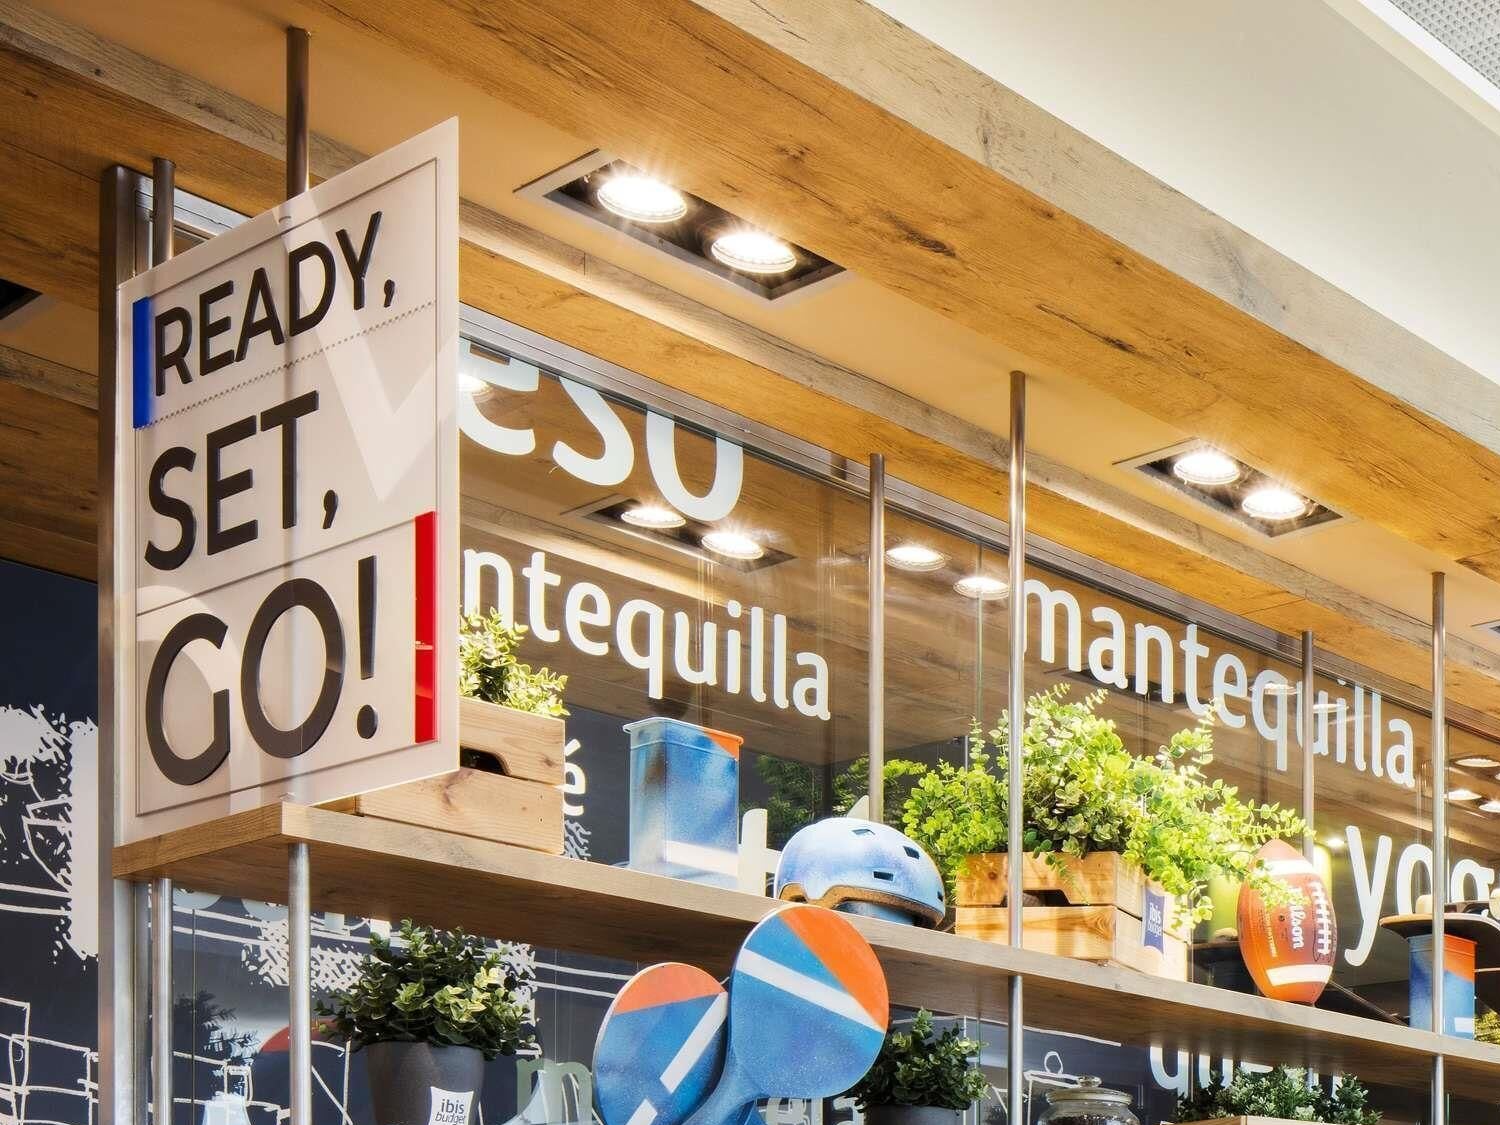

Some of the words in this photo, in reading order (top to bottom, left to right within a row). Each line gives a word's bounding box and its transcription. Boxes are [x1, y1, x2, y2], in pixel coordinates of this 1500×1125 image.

[154, 211, 396, 396] READY,
[145, 391, 340, 571] SET,
[459, 337, 744, 521] eso
[148, 555, 379, 785] GO!
[463, 548, 831, 721] ntequilla
[1022, 578, 1416, 788] mantequilla
[435, 1111, 466, 1125] budget
[441, 1098, 465, 1114] ibis
